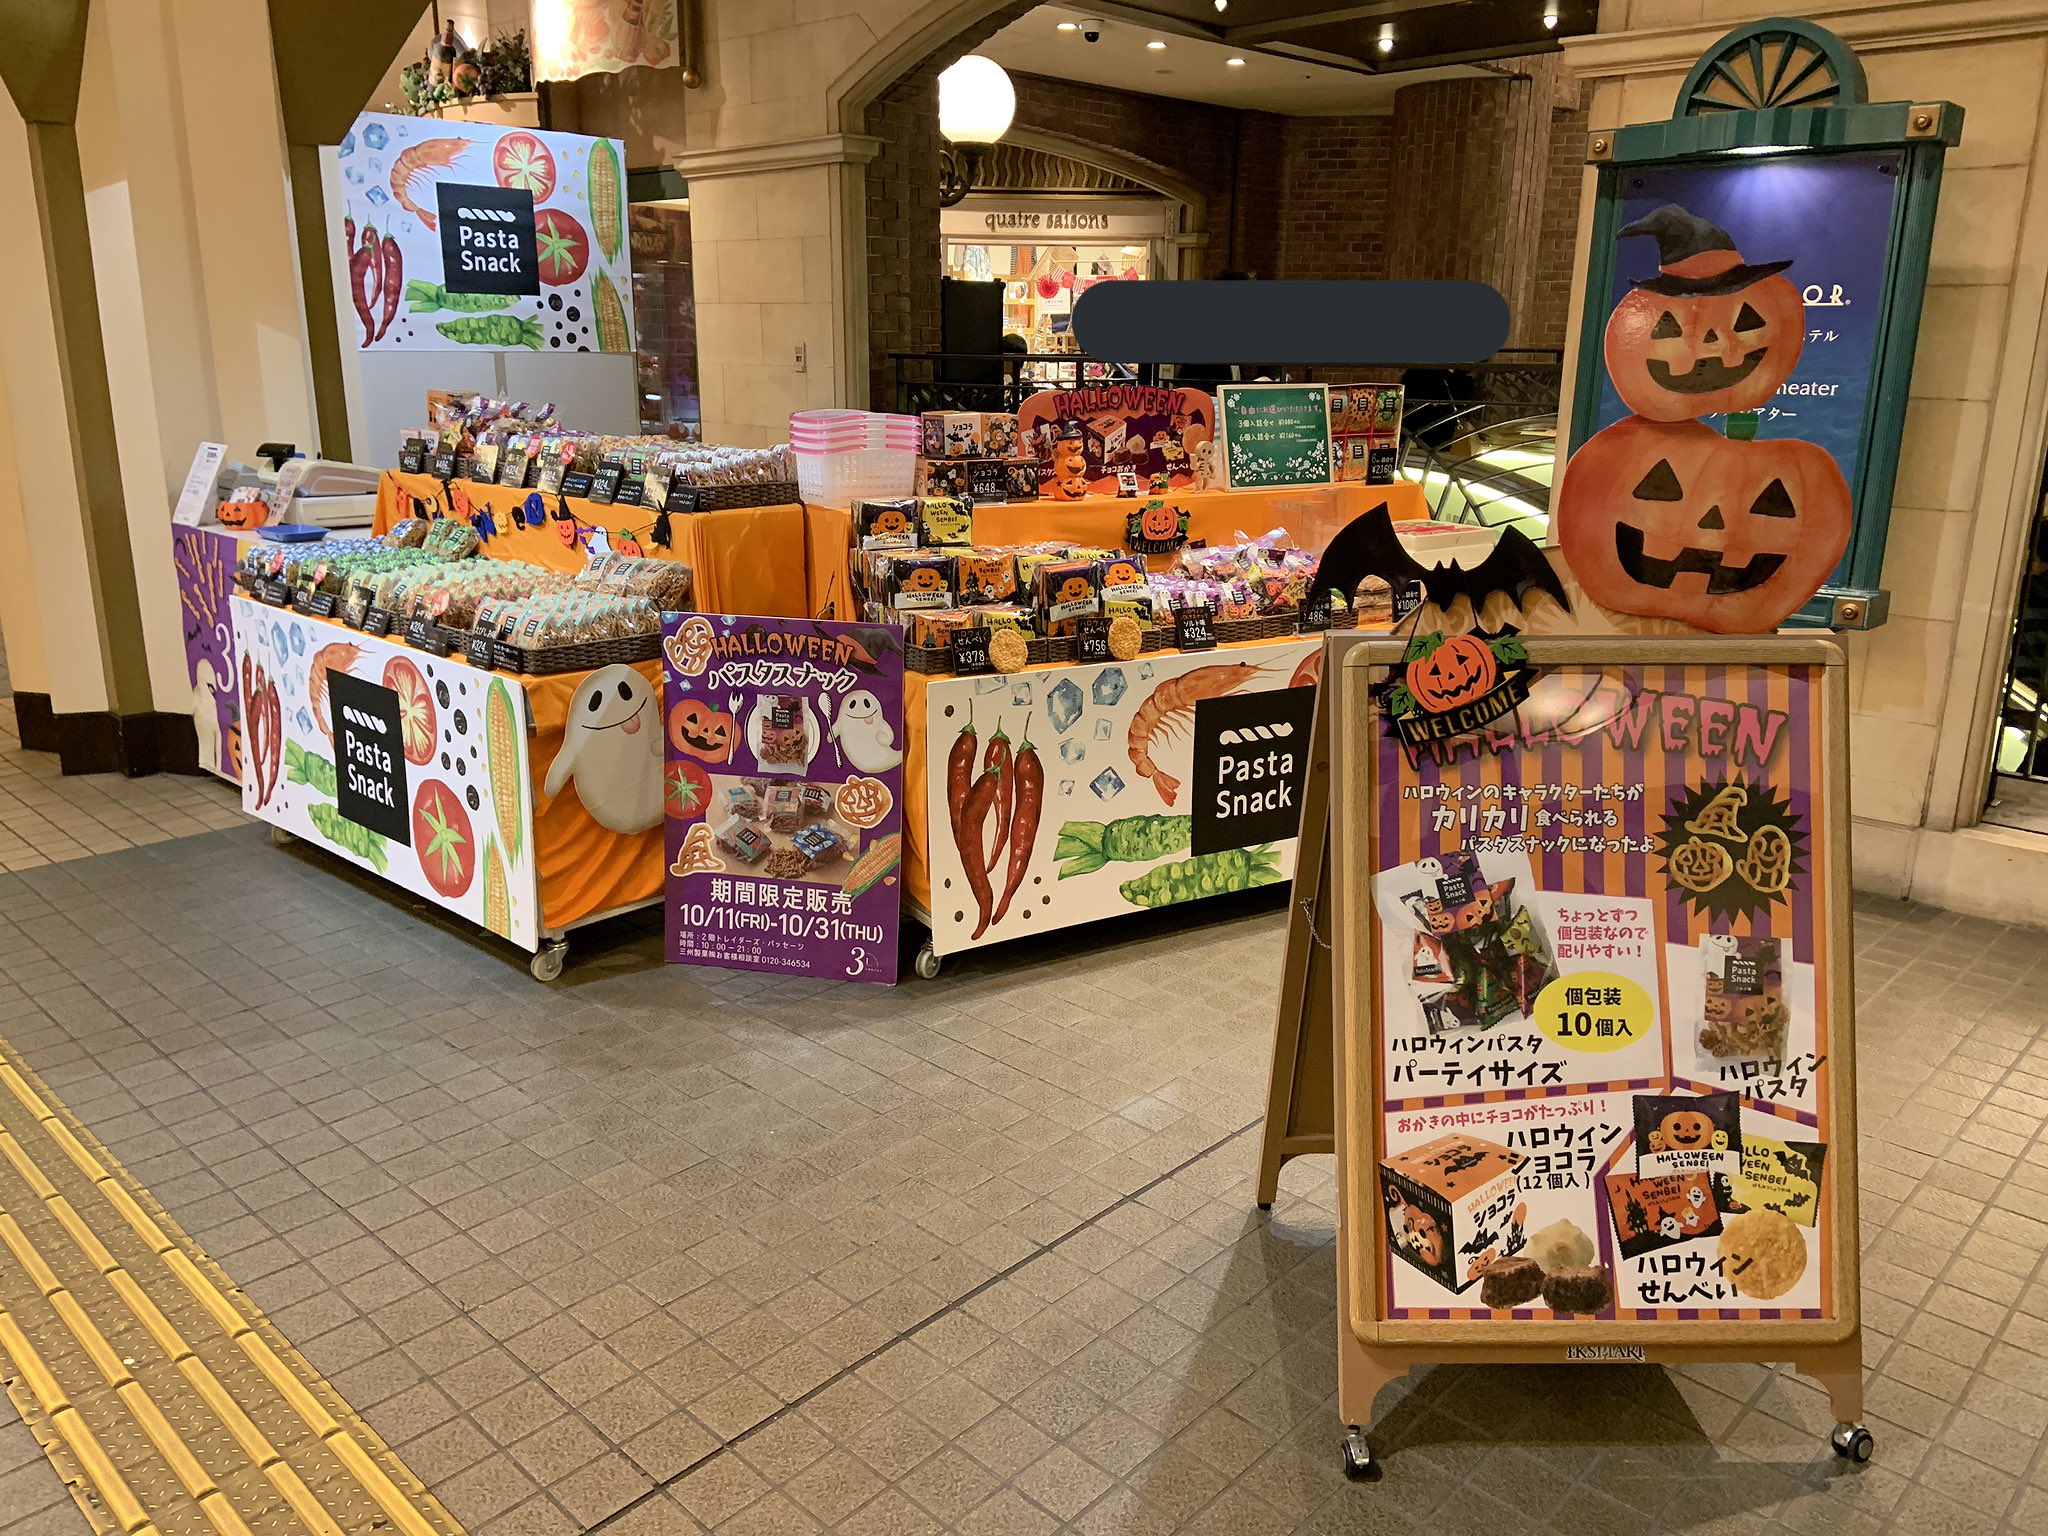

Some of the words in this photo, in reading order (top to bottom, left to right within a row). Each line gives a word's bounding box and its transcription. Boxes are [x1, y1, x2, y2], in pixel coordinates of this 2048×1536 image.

[985, 211, 1041, 232] quatre
[1046, 209, 1109, 230] saisons
[459, 226, 519, 250] Pasta
[461, 251, 522, 274] Snack
[1803, 329, 1840, 343] テル
[1776, 381, 1839, 396] heater
[1053, 384, 1186, 419] HALLOWEEN
[953, 423, 973, 431] ショコラ
[973, 469, 998, 477] ショコラ
[1101, 464, 1137, 474] チョコおかき
[973, 482, 996, 493] ¥648
[1111, 585, 1143, 593] HALLOWEEN
[1061, 600, 1093, 610] HALLOWEEN
[1108, 606, 1132, 614] HALLO
[987, 617, 1012, 626] HALLO
[958, 636, 987, 645] せんべい
[1183, 627, 1207, 639] ¥324
[709, 632, 856, 667] HALLOWEEN
[1084, 640, 1106, 651] ¥756
[958, 650, 985, 664] ¥378
[708, 659, 858, 693] パスタスナック
[1406, 681, 1522, 743] WELCOME
[345, 730, 392, 774] Pasta
[1218, 751, 1294, 785] Pasta
[348, 764, 395, 808] Snack
[1216, 780, 1292, 819] Snack
[1460, 836, 1656, 853] パスタスナックになったよ
[1443, 881, 1465, 892] Pasta
[1444, 889, 1467, 899] Snack
[710, 879, 853, 915] 期間限定販売
[1557, 908, 1638, 923] ちょっとずつ
[680, 903, 884, 944] 10/11(FRI)-10/31(THU)
[1557, 926, 1650, 941] 個包装なので
[761, 956, 811, 969] 0120-346534
[1731, 966, 1757, 976] Pasta
[1731, 974, 1756, 984] Snack
[1565, 987, 1622, 1006] 個包装
[1557, 1012, 1633, 1037] 10個入
[1392, 1034, 1544, 1054] ハロウィンパスタ
[1392, 1059, 1567, 1086] パーティサイズ
[1721, 1053, 1827, 1081] ハロウィン
[1745, 1076, 1808, 1100] パスタ
[1506, 1123, 1622, 1149] ハロウィン
[1656, 1152, 1724, 1163] HALLOWEEN
[1745, 1145, 1770, 1157] LLO
[1507, 1148, 1596, 1175] ショコラ
[1672, 1160, 1709, 1168] SENBEI
[1653, 1174, 1685, 1188] WEEN
[1745, 1170, 1788, 1185] SENBEI
[1642, 1184, 1681, 1200] SENBEI
[1473, 1189, 1516, 1228] ショコラ
[1637, 1251, 1754, 1277] ハロウィン
[1637, 1280, 1738, 1304] せんべい
